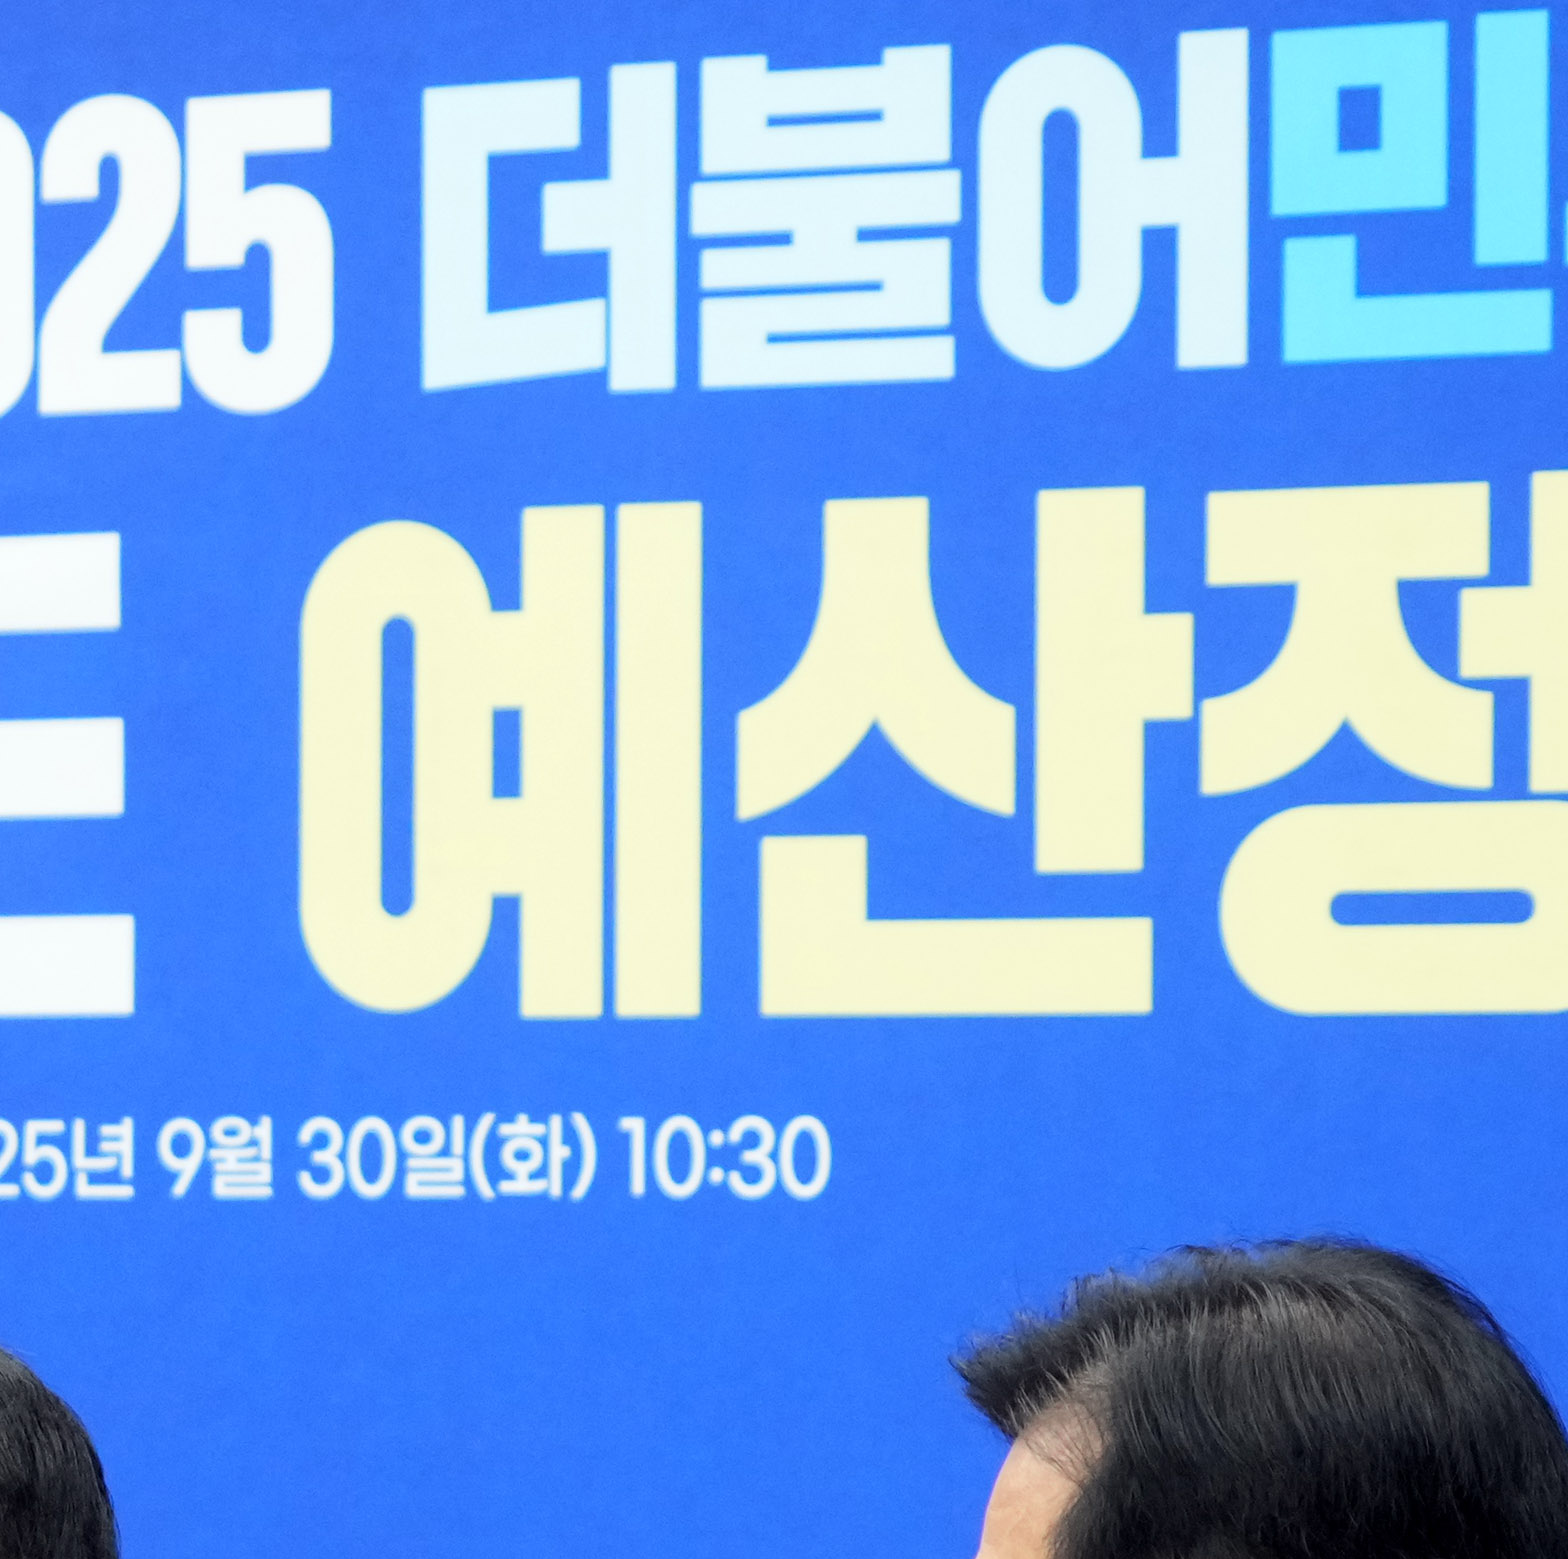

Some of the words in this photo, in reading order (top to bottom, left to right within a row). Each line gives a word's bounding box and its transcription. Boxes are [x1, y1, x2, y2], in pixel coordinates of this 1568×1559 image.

[419, 8, 1568, 397] 더불어민
[297, 468, 1568, 1022] 예산정
[155, 1114, 275, 1201] 9월
[295, 1111, 598, 1202] 30일(화)
[617, 1113, 833, 1202] 10:30
